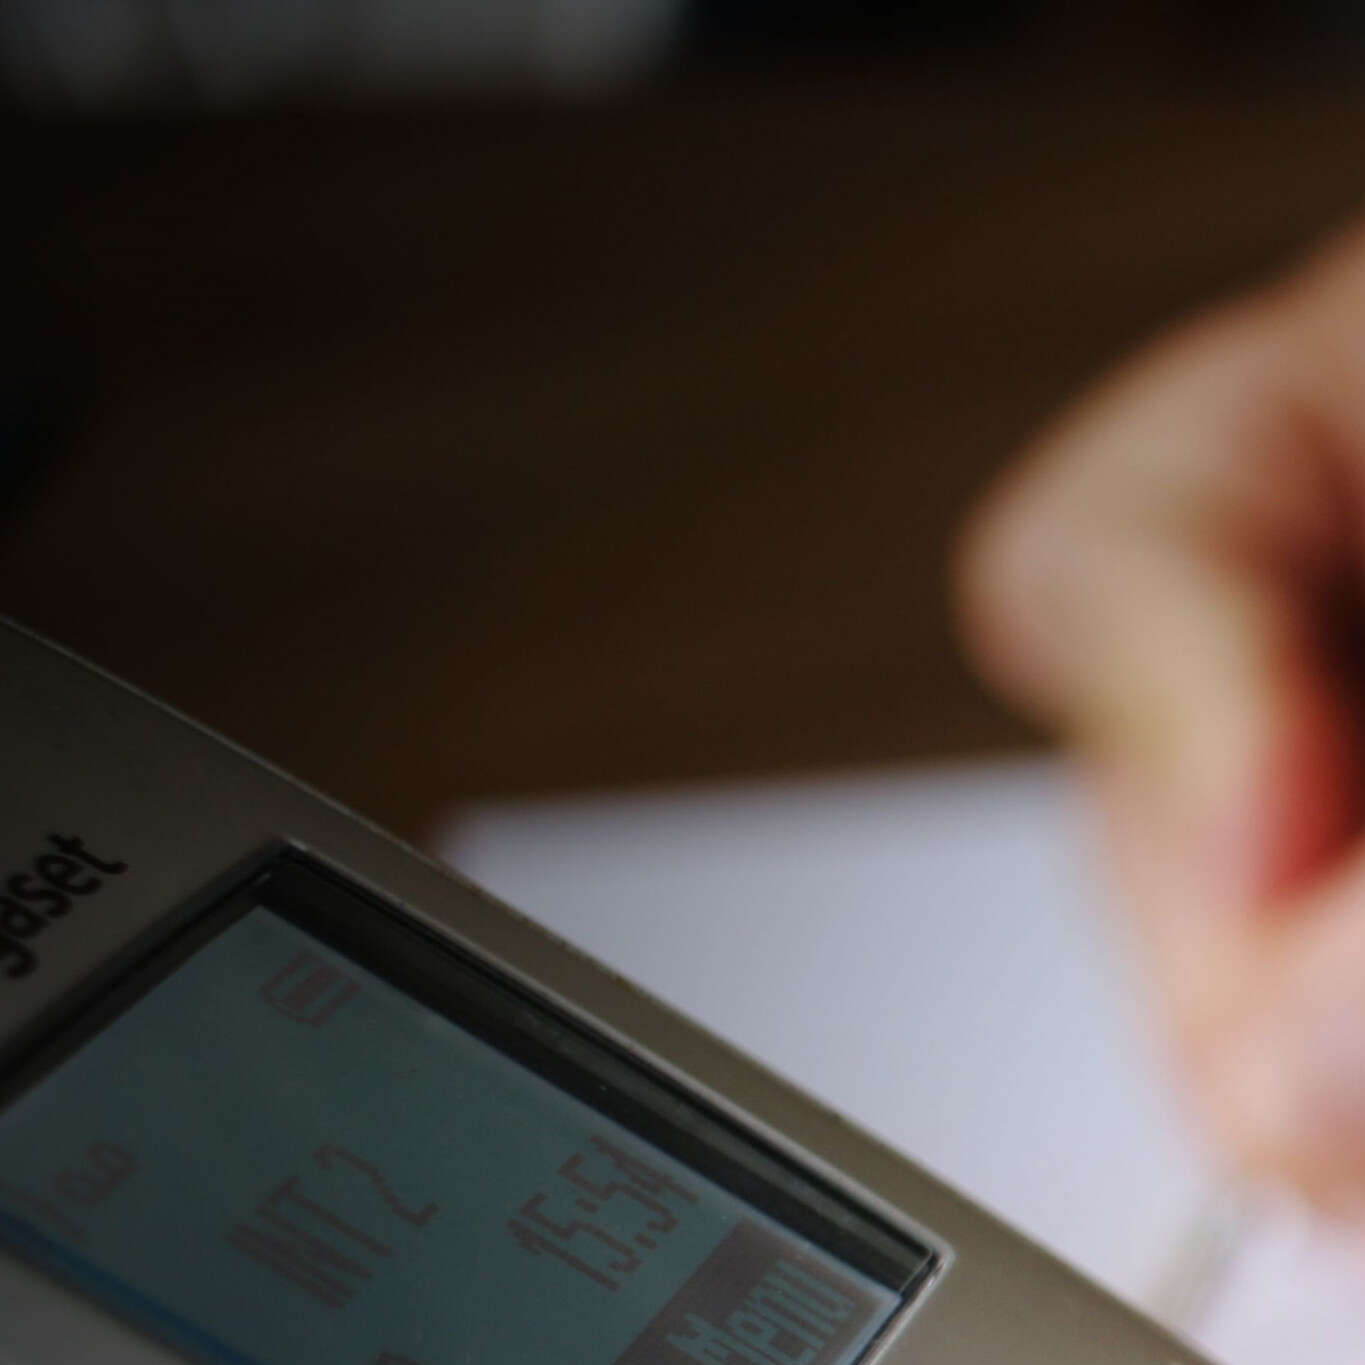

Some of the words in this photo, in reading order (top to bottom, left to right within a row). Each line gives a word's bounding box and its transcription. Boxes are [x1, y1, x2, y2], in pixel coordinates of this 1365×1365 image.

[224, 1175, 397, 1309] INT
[313, 1143, 441, 1228] 2
[507, 1133, 700, 1292] 15:54
